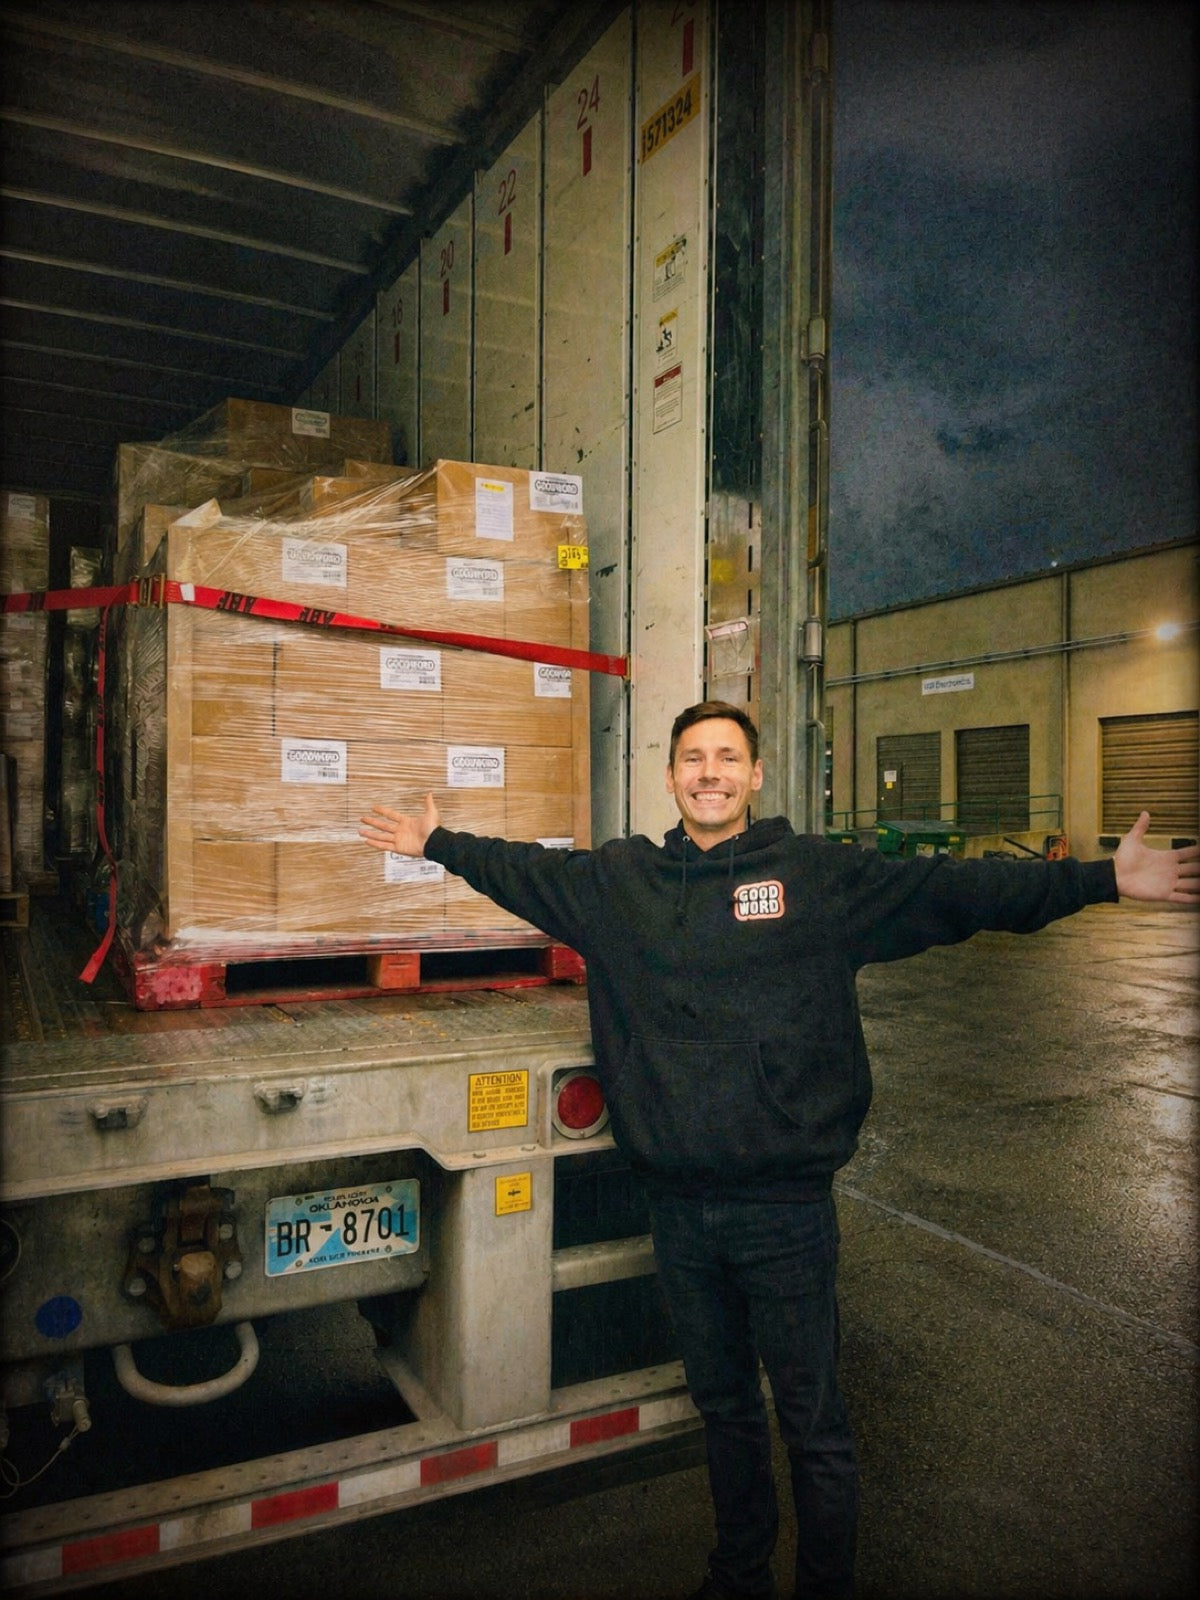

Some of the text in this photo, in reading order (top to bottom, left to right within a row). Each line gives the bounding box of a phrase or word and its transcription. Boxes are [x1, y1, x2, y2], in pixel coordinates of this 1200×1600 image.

[577, 74, 600, 130] 24
[642, 88, 692, 160] 1571324
[498, 169, 516, 216] 22
[440, 240, 455, 278] 20
[738, 885, 779, 902] GOOD
[739, 899, 779, 916] WORD
[475, 1073, 522, 1086] ATTENTION
